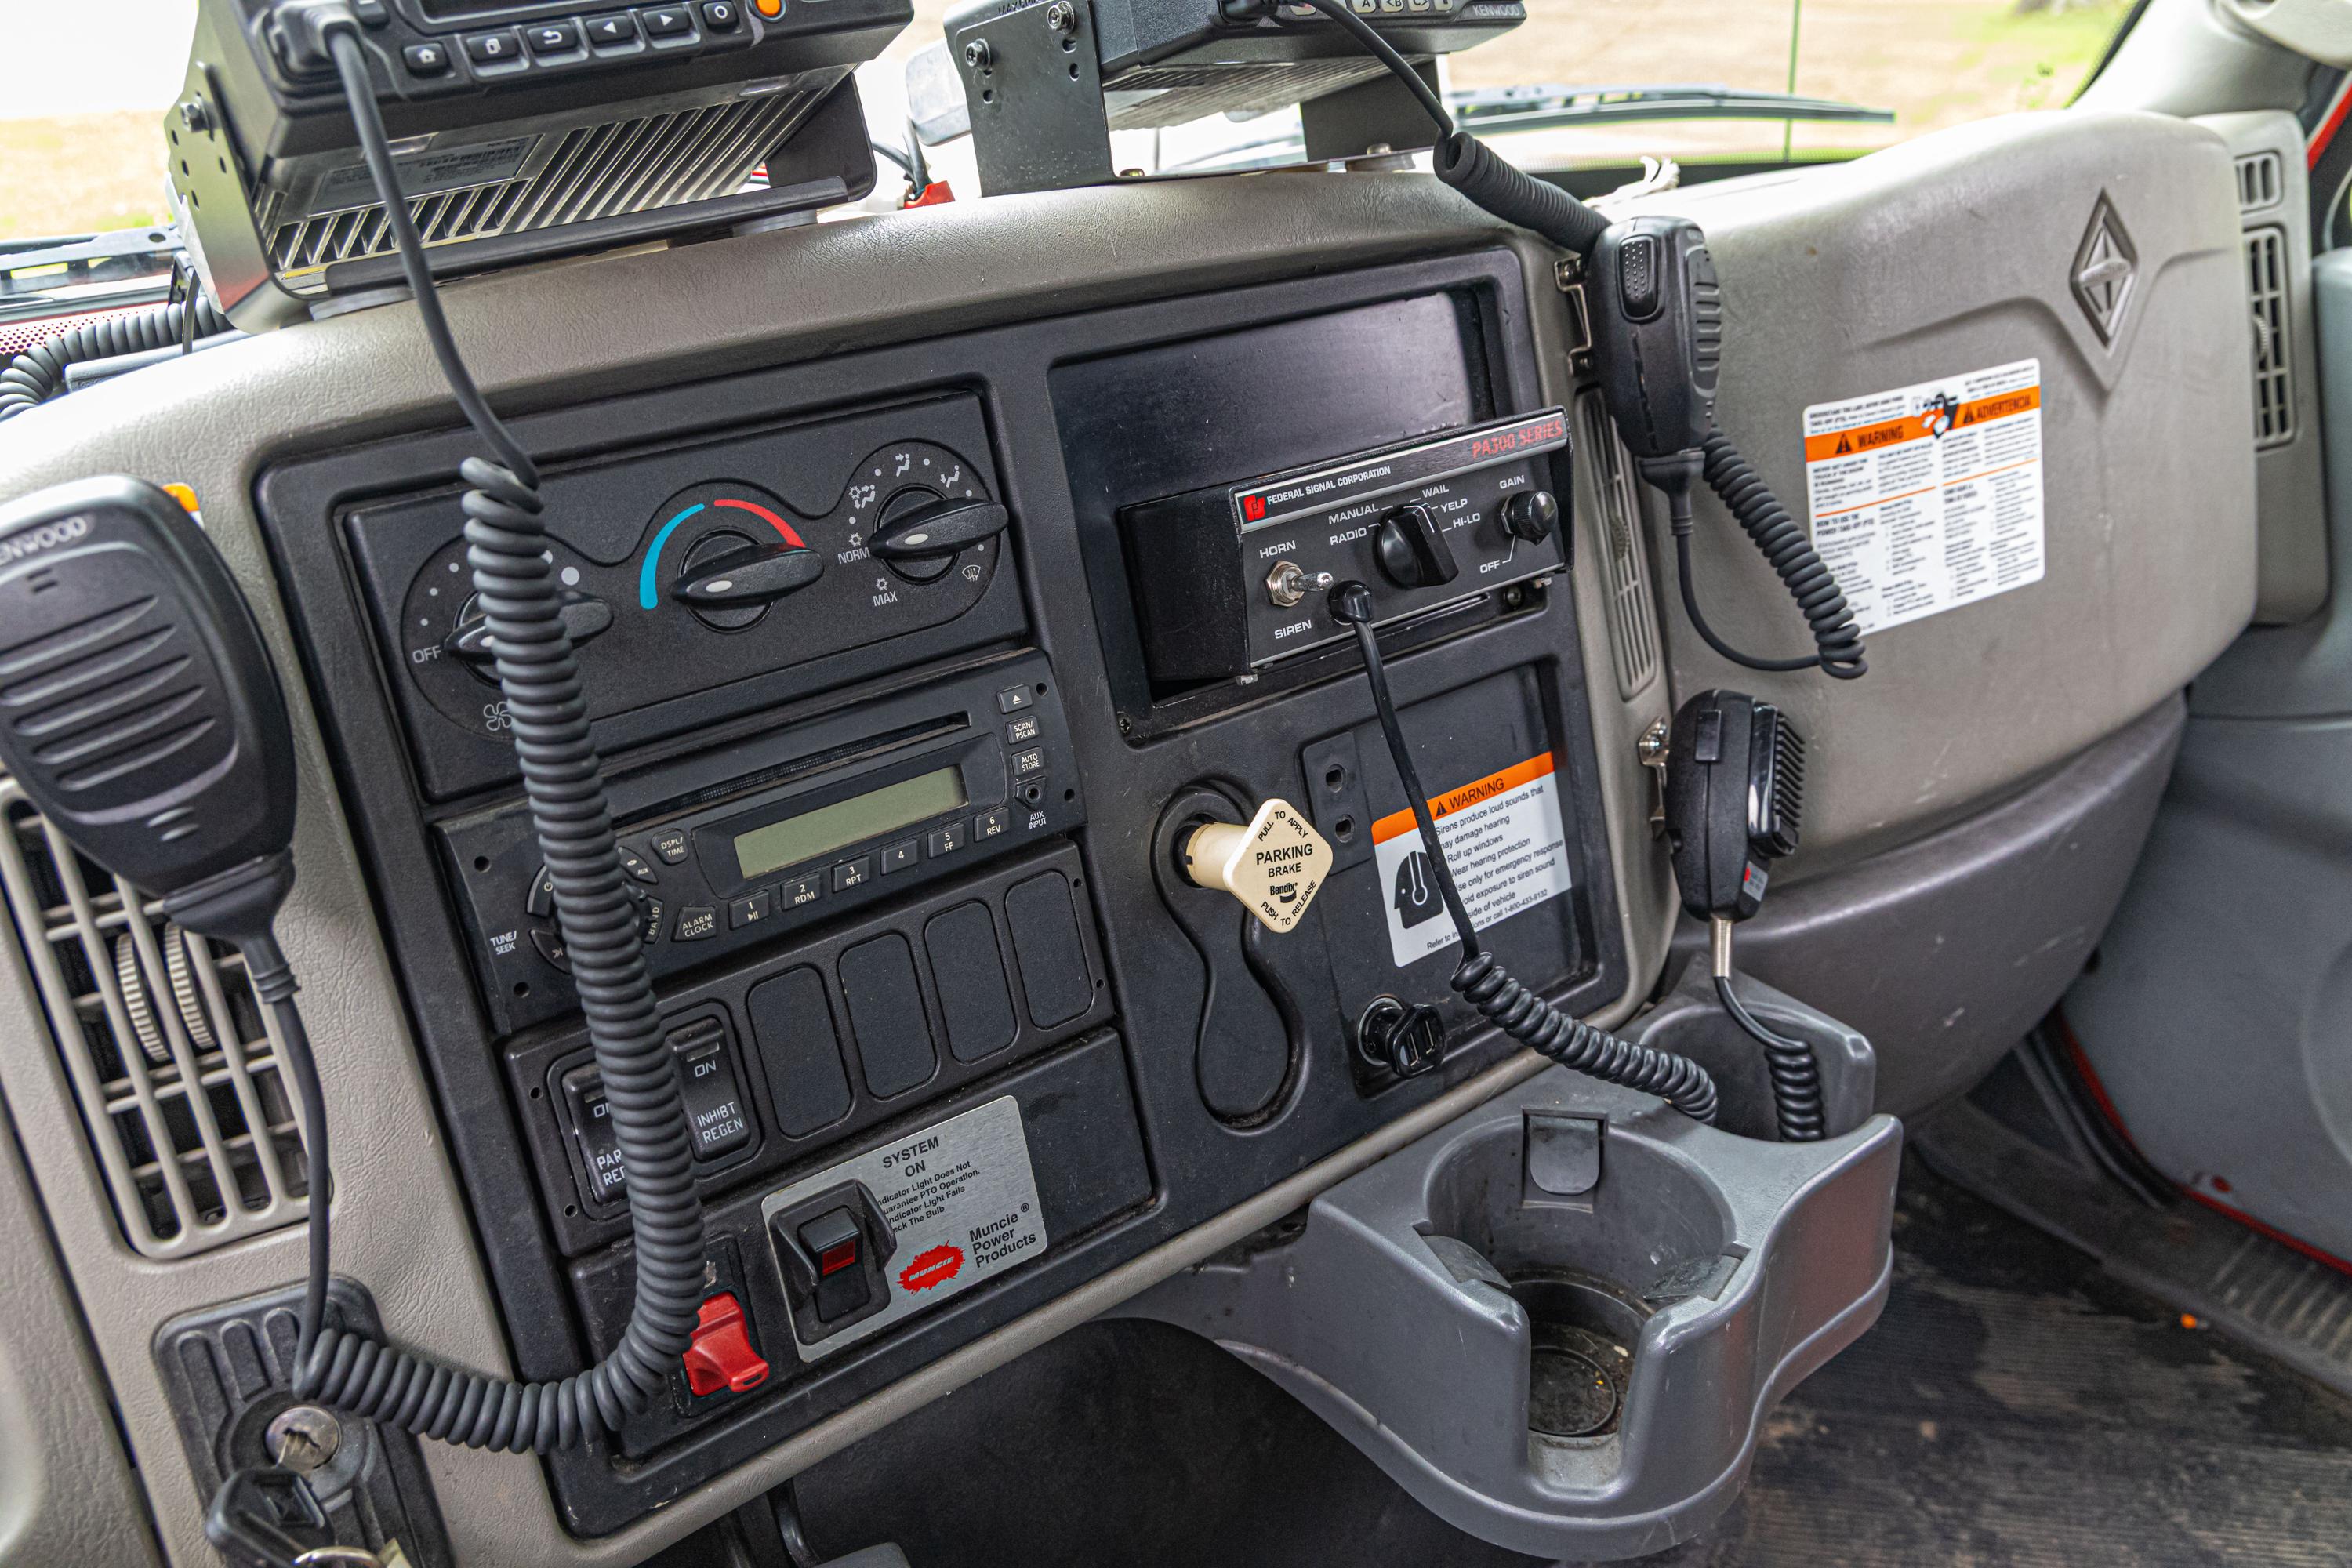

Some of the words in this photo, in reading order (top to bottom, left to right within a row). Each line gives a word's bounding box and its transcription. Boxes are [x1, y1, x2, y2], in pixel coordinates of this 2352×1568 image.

[1472, 4, 1520, 16] KENWOOD
[1976, 394, 2031, 419] ADVERTENCIA
[1472, 434, 1515, 459] PA300
[1519, 420, 1563, 446] SERIES
[1857, 424, 1904, 448] WARNING
[1267, 489, 1304, 505] FEDERAL
[1305, 480, 1335, 495] SIGNAL
[1338, 466, 1391, 487] CORPORATION
[1499, 474, 1525, 489] GAIN
[1422, 484, 1450, 499] WAIL
[1328, 503, 1379, 524] MANUAL
[1440, 498, 1468, 513] YELP
[1453, 512, 1481, 528] HI-LO
[0, 516, 87, 565] ENWOOD
[1329, 527, 1367, 546] RADIO
[837, 546, 870, 564] NORM
[1259, 540, 1297, 559] HORN
[1479, 559, 1501, 574] OFF
[873, 590, 898, 607] MAX
[1274, 619, 1312, 640] SIREN
[412, 644, 441, 663] OFF
[1013, 720, 1033, 732] SCAN/
[1015, 728, 1036, 740] PSCAN
[1021, 753, 1038, 764] AUTO
[1022, 760, 1040, 771] STORE
[1449, 778, 1504, 809] WARNING
[1029, 811, 1044, 822] AUX
[1436, 822, 1458, 836] Sirens
[1460, 808, 1488, 828] produce
[1489, 800, 1504, 816] loud
[1504, 793, 1529, 808] sounds
[1530, 784, 1544, 797] that
[989, 816, 995, 825] 6
[1029, 817, 1047, 830] INPUT
[1258, 821, 1274, 842] PULL
[1275, 811, 1286, 820] TO
[1287, 818, 1308, 839] APPLY
[1454, 827, 1483, 844] damage
[1484, 815, 1510, 832] hearing
[945, 832, 951, 841] 5
[986, 824, 1001, 837] REV
[660, 836, 684, 850] DSPL/
[666, 846, 685, 858] TIME
[944, 841, 953, 852] FF
[1447, 850, 1461, 863] Roll
[1463, 848, 1472, 857] up
[1473, 835, 1503, 852] windows
[898, 851, 904, 860] 4
[1256, 843, 1313, 866] PARKING
[1470, 853, 1496, 869] hearing
[1497, 838, 1530, 859] protection
[637, 867, 649, 876] AUX
[849, 866, 855, 875] 3
[1268, 862, 1301, 878] BRAKE
[1468, 874, 1483, 887] only
[1484, 870, 1494, 880] for
[1495, 853, 1532, 875] emergency
[1534, 840, 1563, 858] response
[800, 884, 806, 893] 2
[845, 873, 862, 887] RPT
[1463, 893, 1475, 905] oid
[1476, 880, 1508, 899] exposure
[1517, 868, 1534, 881] siren
[1535, 857, 1555, 873] sound
[794, 891, 815, 905] RDM
[1261, 901, 1279, 920] PUSH
[1280, 917, 1291, 927] TO
[1291, 880, 1317, 916] RELEASE
[1483, 901, 1490, 912] of
[1491, 891, 1515, 907] vehicle
[682, 913, 713, 931] ALARM
[684, 921, 713, 938] CLOCK
[1427, 938, 1443, 950] Refer
[1493, 909, 1503, 920] call
[490, 930, 517, 947] TUNE/
[495, 942, 516, 955] SEEK
[694, 1060, 717, 1078] ON
[697, 1102, 736, 1128] INHIBT
[702, 1116, 744, 1144] REGEN
[596, 1149, 622, 1171] PAR
[883, 1136, 940, 1169] SYSTEM
[905, 1160, 926, 1177] ON
[878, 1187, 910, 1206] ndicator
[911, 1177, 933, 1192] Light
[934, 1168, 955, 1183] Does
[956, 1160, 971, 1172] Not
[883, 1196, 919, 1215] uarantee
[920, 1185, 938, 1199] PTO
[939, 1170, 981, 1192] Operation.
[889, 1204, 922, 1224] ndicator
[924, 1194, 945, 1208] Light
[946, 1186, 966, 1201] Fails
[892, 1221, 908, 1234] eck
[908, 1215, 924, 1226] The
[926, 1206, 945, 1219] Bulb
[969, 1212, 1018, 1243] Muncie
[972, 1229, 1015, 1255] Power
[975, 1232, 1036, 1268] Products
[909, 1256, 954, 1282] MUNCIE
